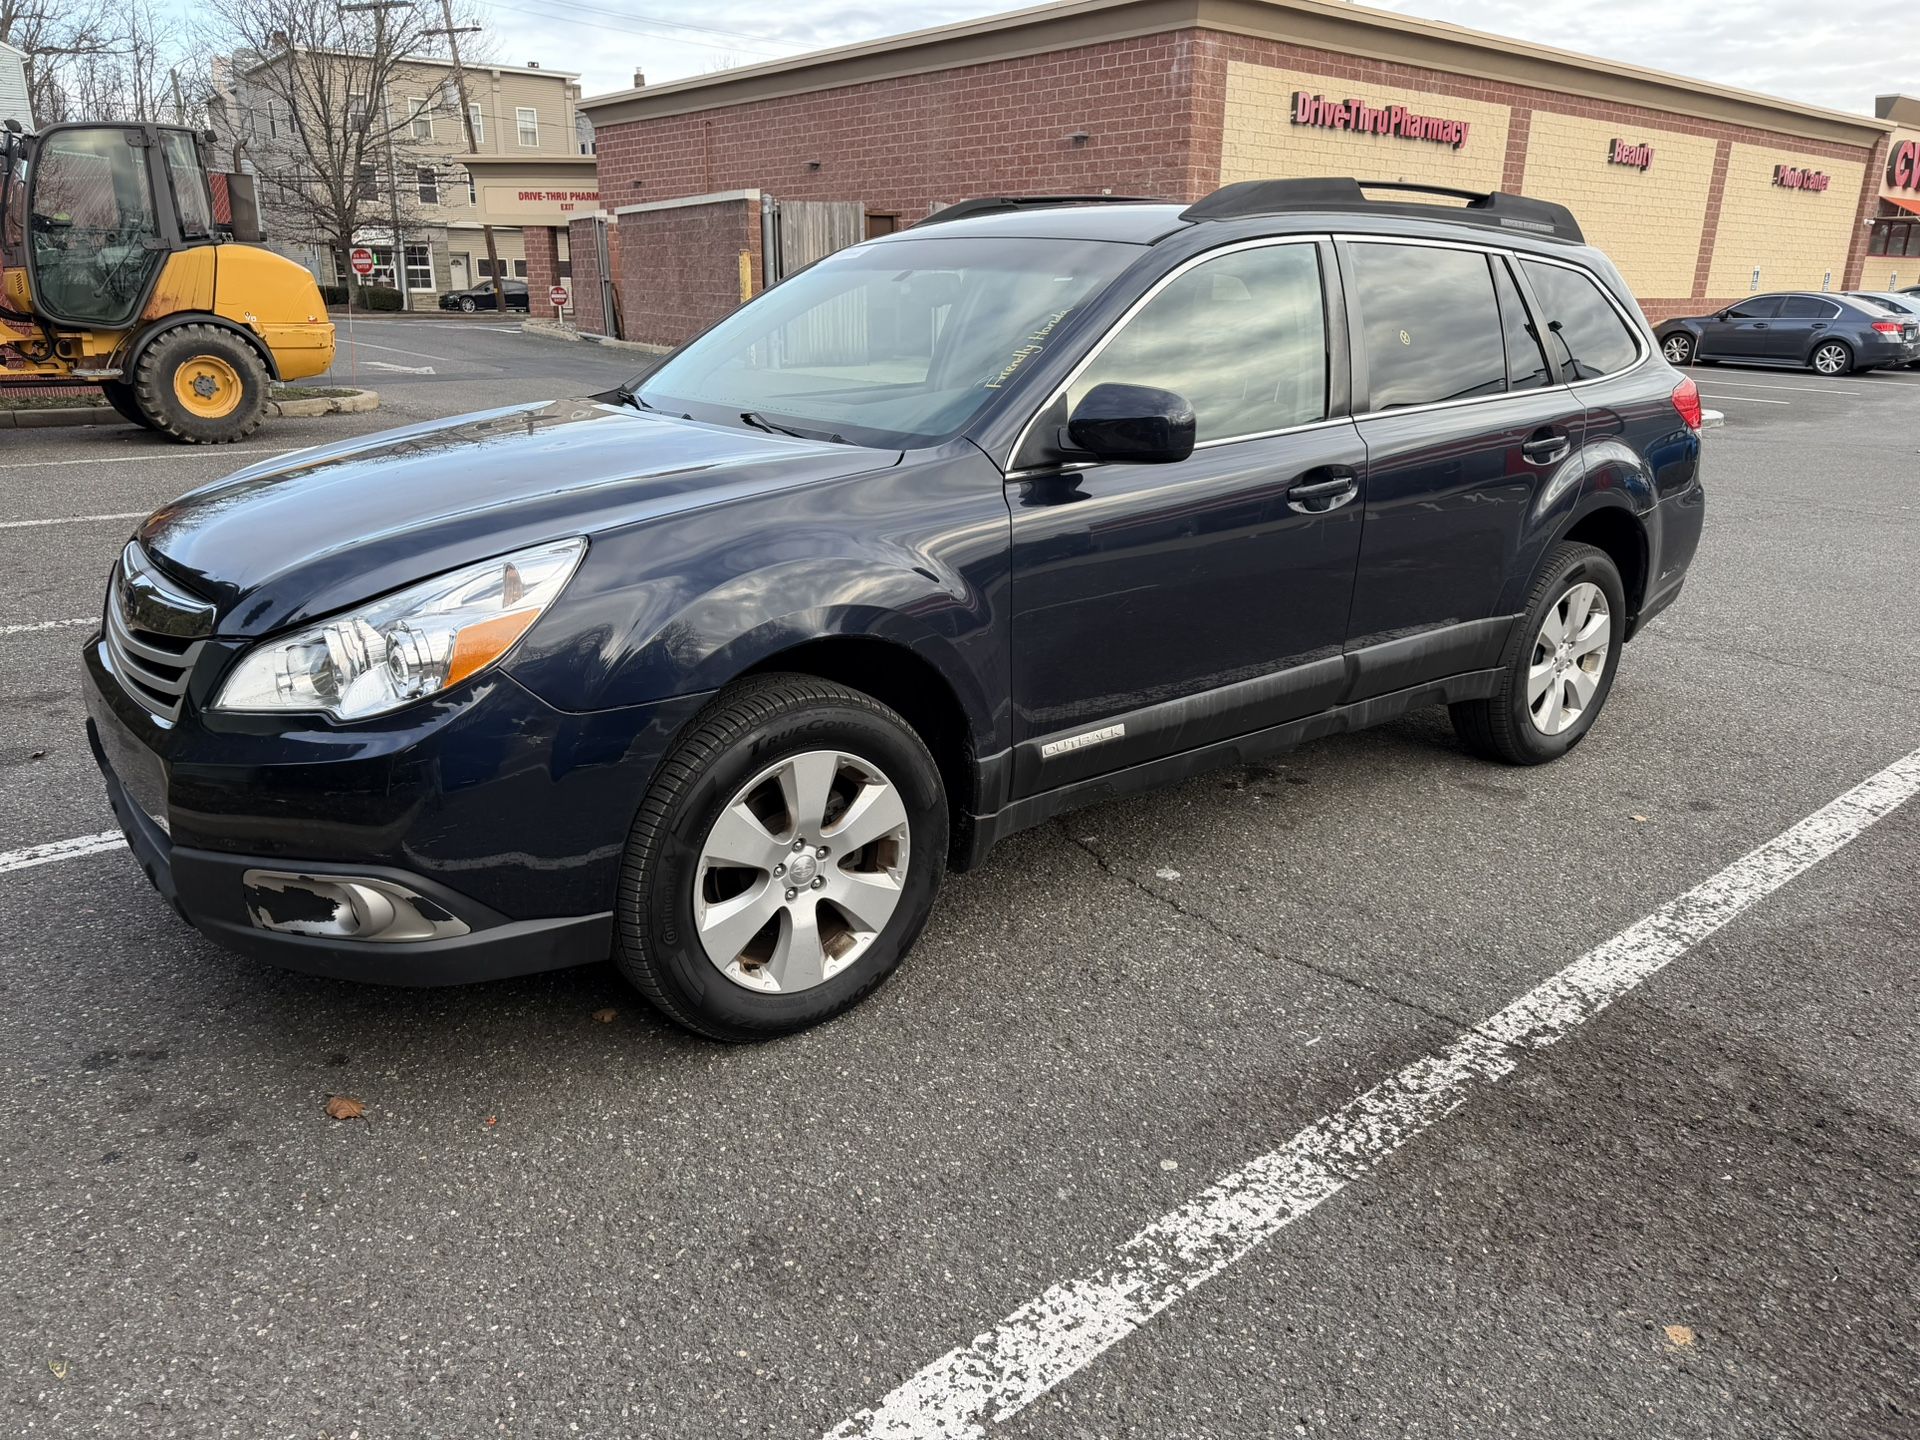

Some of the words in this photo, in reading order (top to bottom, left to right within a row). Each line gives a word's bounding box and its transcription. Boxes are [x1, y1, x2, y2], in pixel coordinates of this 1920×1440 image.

[1295, 91, 1389, 134] Drive-Thru
[1390, 105, 1470, 149] Pharmacy
[1613, 138, 1655, 170] Beauty
[1777, 165, 1802, 188] Photo
[518, 192, 567, 201] DRIVE-THRU
[560, 203, 574, 211] EXIT
[976, 344, 1043, 388] Friendly
[1028, 308, 1073, 340] Honda
[1043, 725, 1123, 757] OUTBACK
